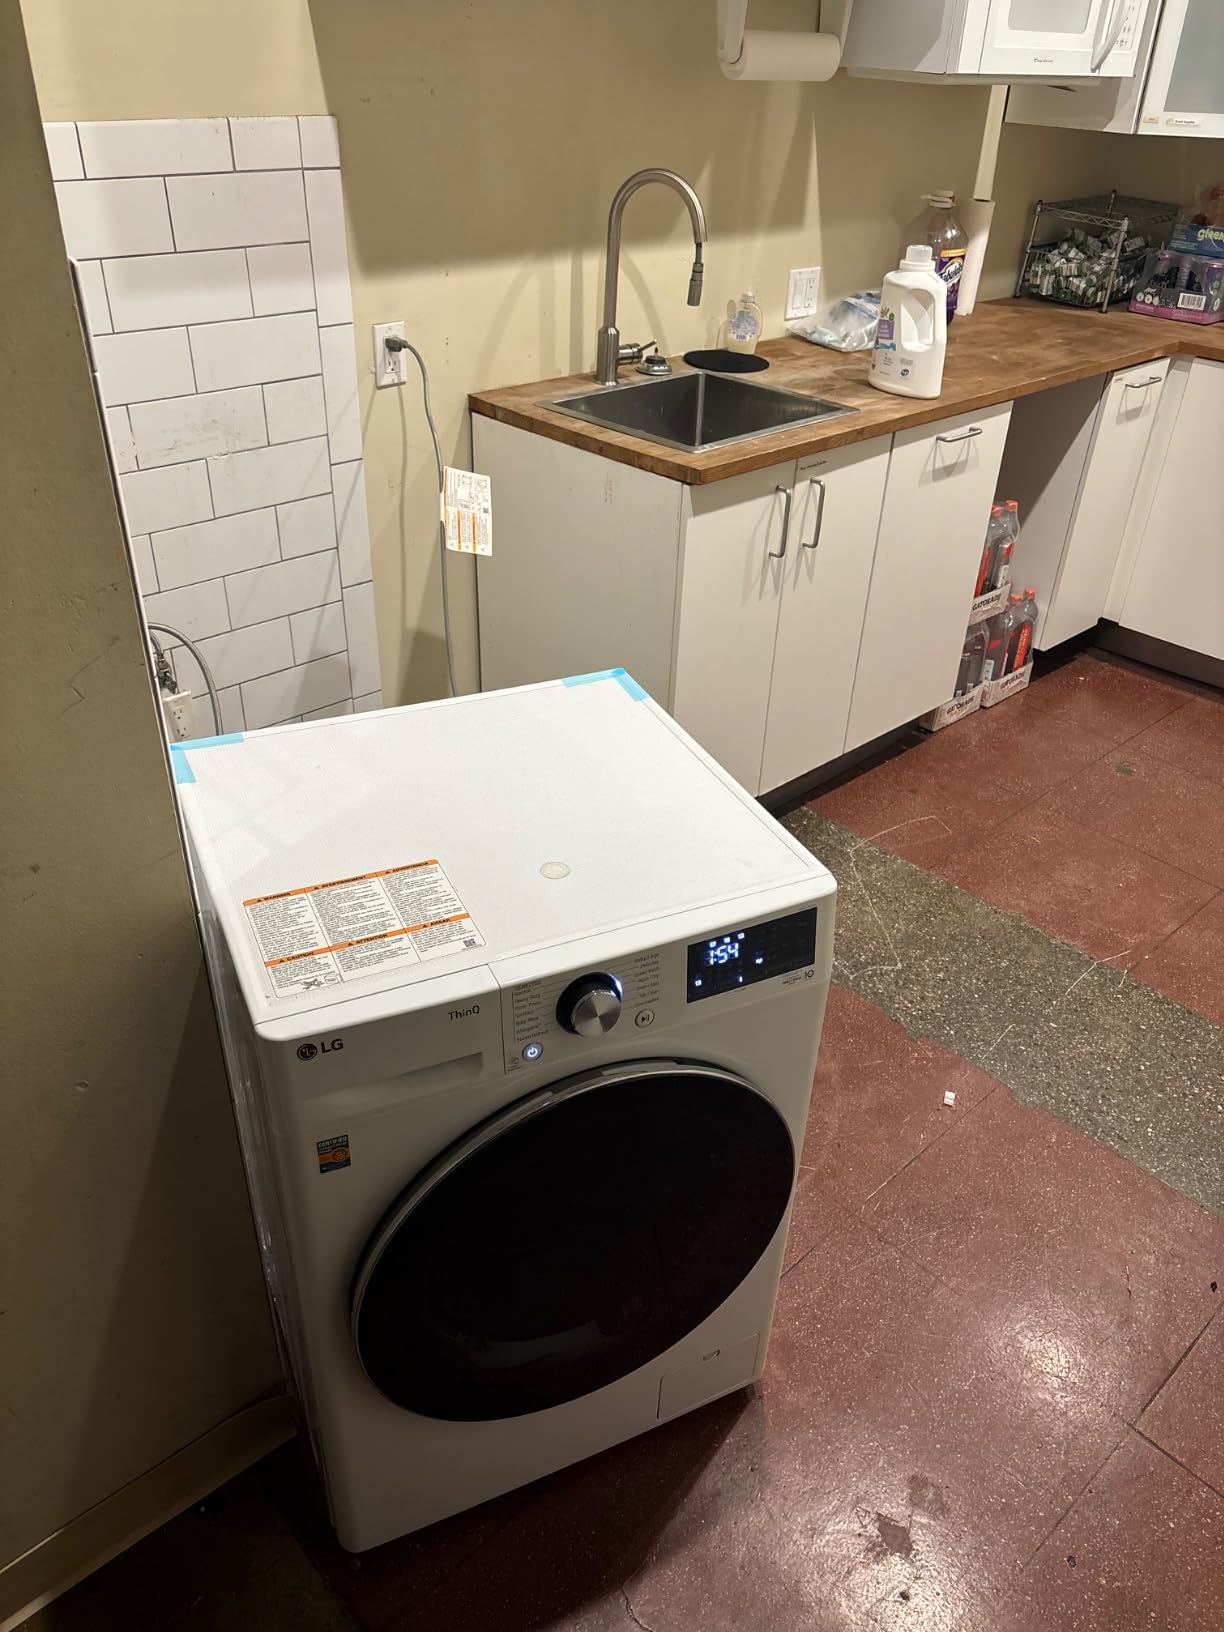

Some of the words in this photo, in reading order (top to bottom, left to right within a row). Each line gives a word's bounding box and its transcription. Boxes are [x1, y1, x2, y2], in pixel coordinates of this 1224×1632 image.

[972, 593, 1002, 611] GATORADE
[946, 695, 975, 715] GATORADE
[356, 933, 388, 944] ATTENTION
[286, 951, 314, 961] CAUTION
[709, 942, 739, 966] 1:54
[448, 1005, 480, 1021] ThinQ
[321, 1038, 344, 1054] LG
